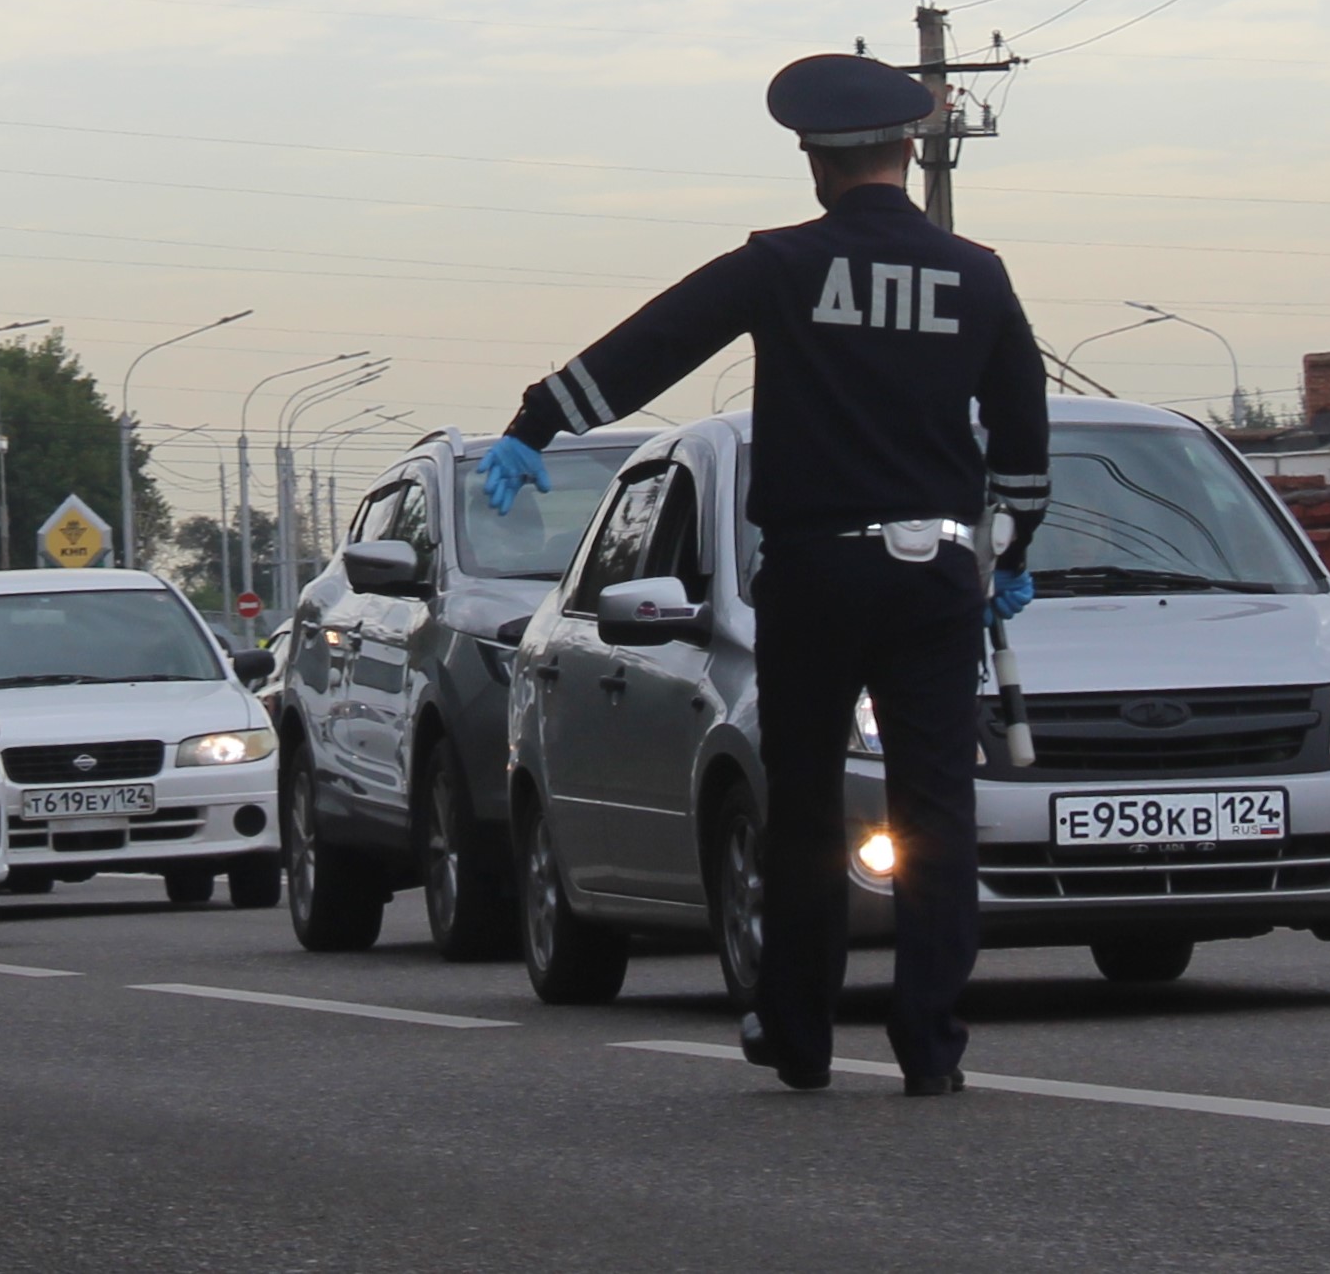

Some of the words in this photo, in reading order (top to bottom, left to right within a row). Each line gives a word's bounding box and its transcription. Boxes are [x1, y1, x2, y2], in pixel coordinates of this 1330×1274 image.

[812, 257, 961, 334] ДПС
[31, 791, 111, 814] Т619ЕУ
[116, 787, 148, 804] 124
[1069, 800, 1212, 839] Е958КВ
[1221, 795, 1275, 824] 124
[1232, 825, 1259, 835] RUS
